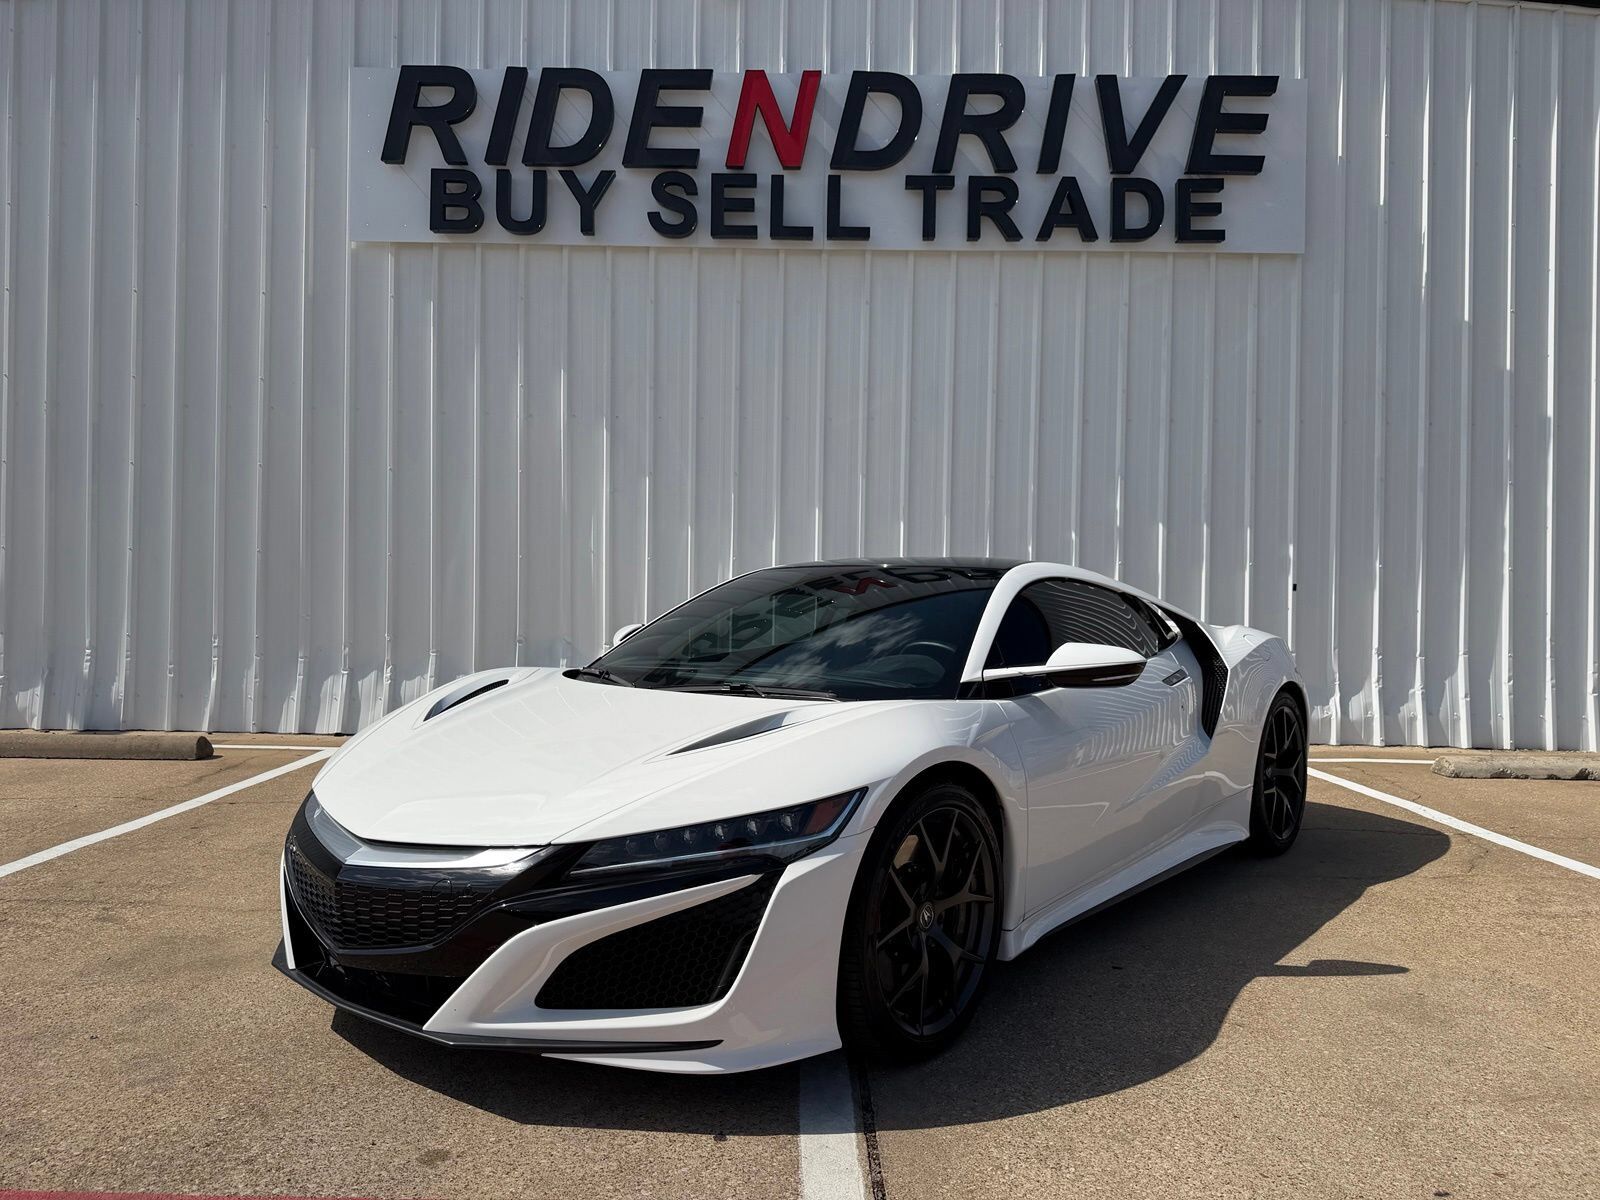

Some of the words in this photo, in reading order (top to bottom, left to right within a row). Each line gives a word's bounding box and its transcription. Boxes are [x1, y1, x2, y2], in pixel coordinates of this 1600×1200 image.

[429, 168, 616, 236] BUY
[647, 171, 870, 237] SELL
[905, 174, 1226, 243] TRADE
